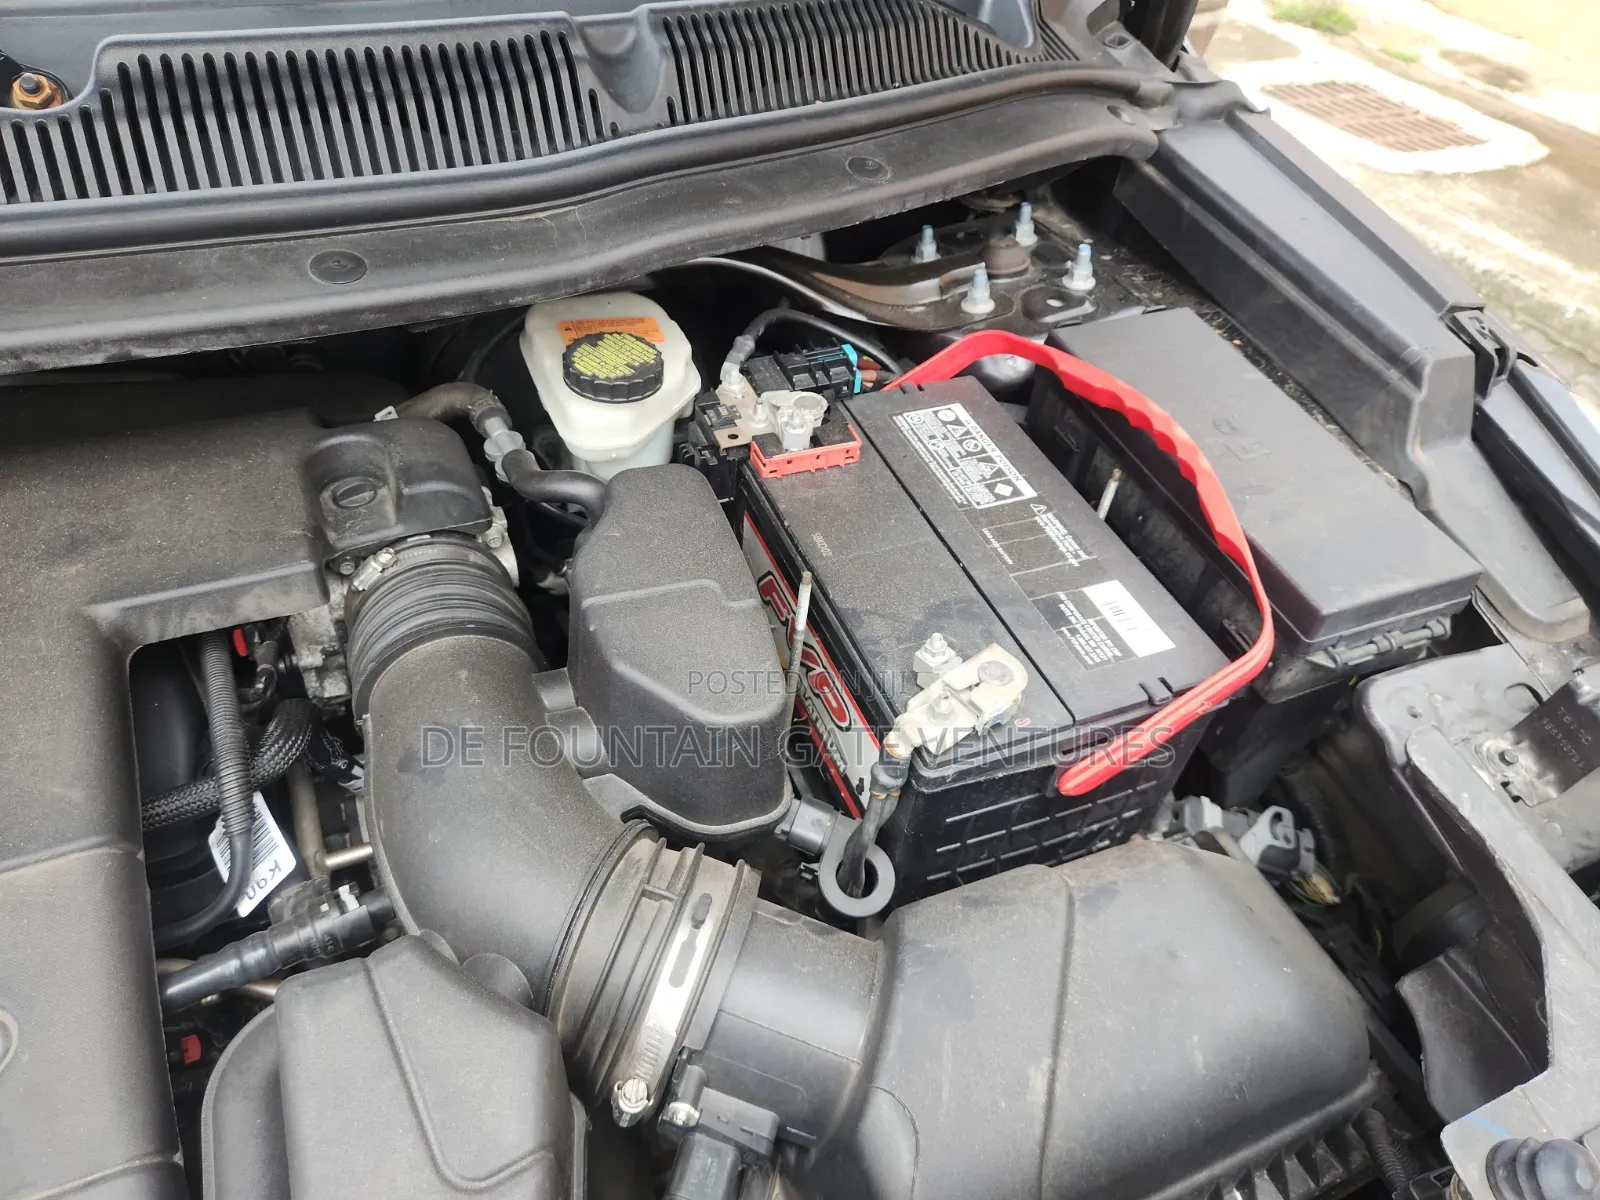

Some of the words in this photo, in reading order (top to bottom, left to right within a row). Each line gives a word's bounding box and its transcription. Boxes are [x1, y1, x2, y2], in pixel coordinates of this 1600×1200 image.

[969, 425, 997, 452] DANGER
[994, 454, 1022, 481] POISON
[797, 676, 848, 777] LATINUM
